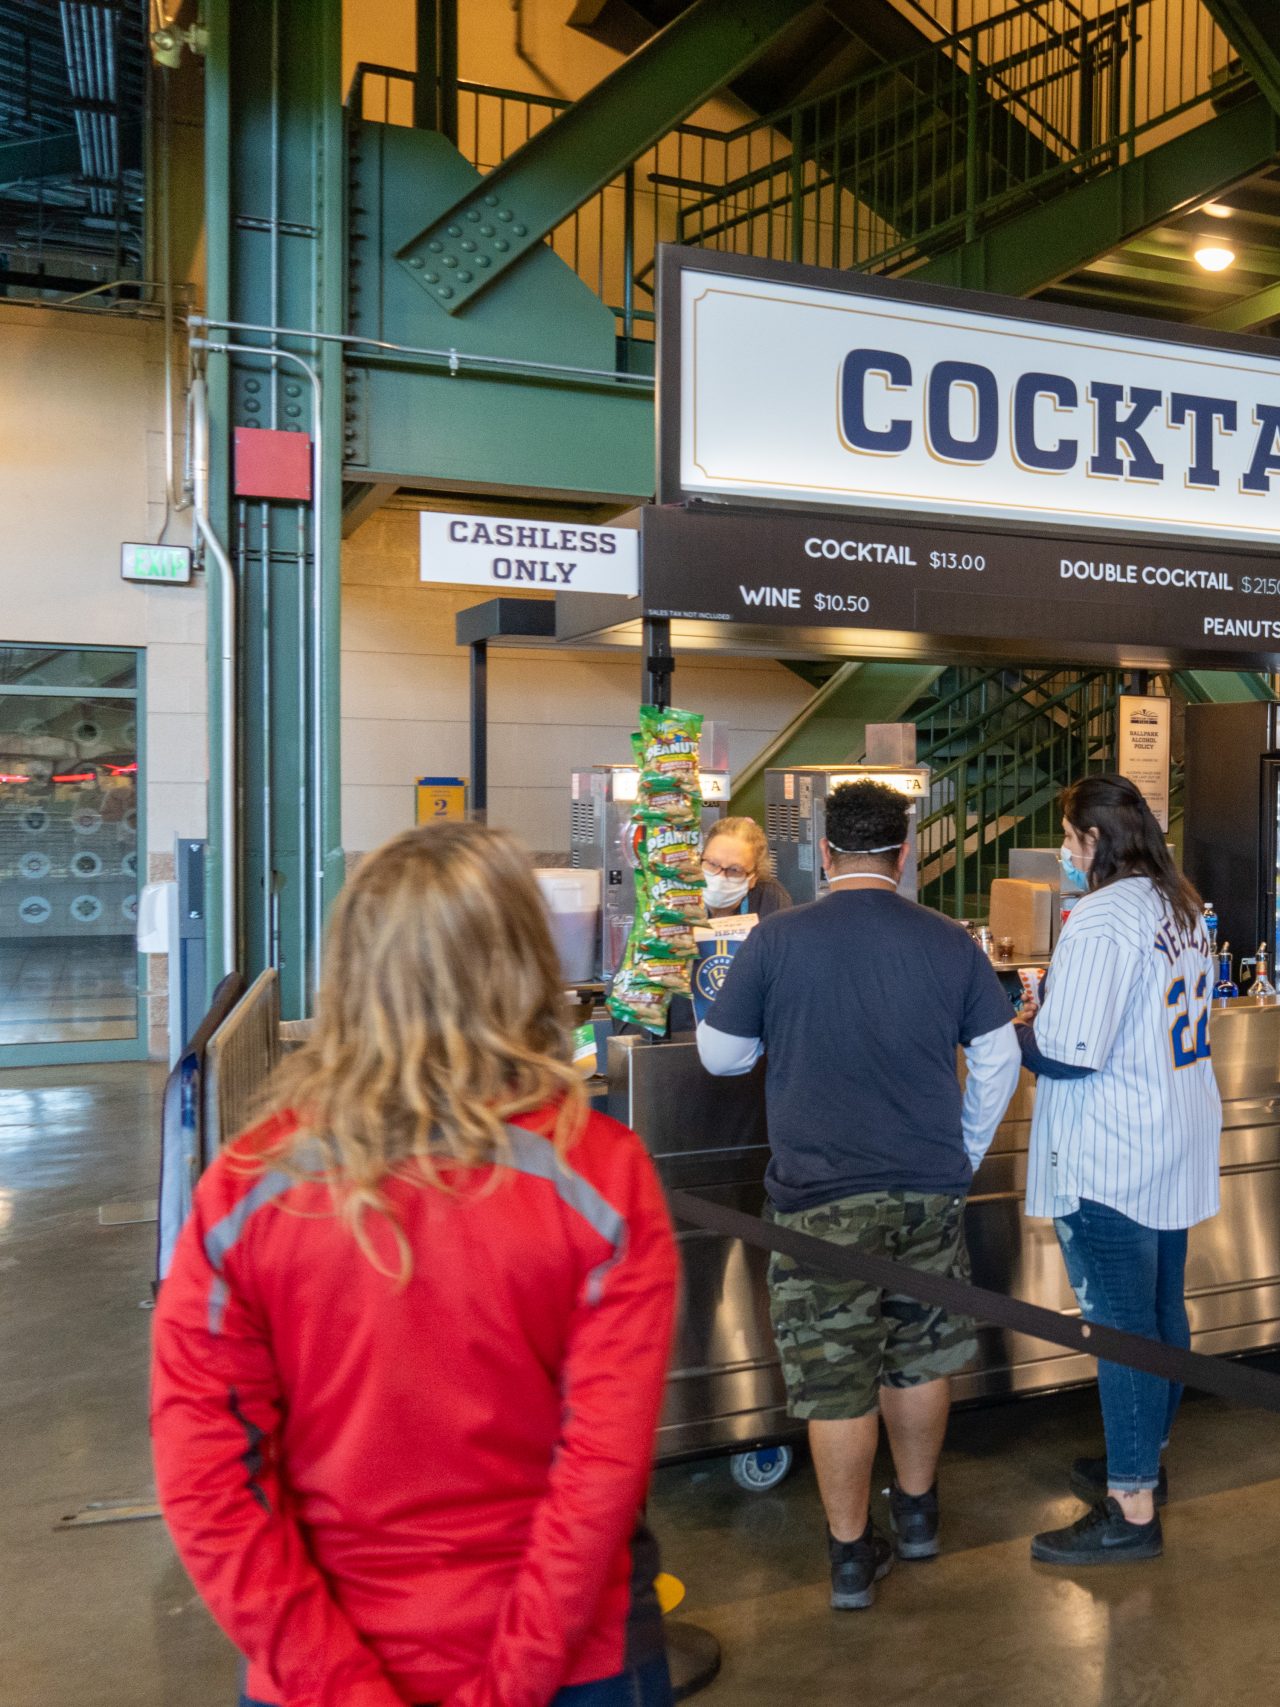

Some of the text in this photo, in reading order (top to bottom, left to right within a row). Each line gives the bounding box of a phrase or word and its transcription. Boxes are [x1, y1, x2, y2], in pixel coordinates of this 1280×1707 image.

[450, 520, 617, 555] CASHLESS
[134, 547, 179, 577] EXIT
[805, 538, 985, 571] COCKTAIL $13.00
[492, 557, 577, 584] ONLY
[1061, 560, 1137, 583] DOUBLE
[1142, 567, 1233, 590] COCKTAIL
[740, 585, 869, 612] WINE $10.50
[1129, 730, 1160, 738] BALLPARK
[1131, 736, 1158, 744] ALCOHOL
[646, 741, 698, 763] PEANUT
[434, 798, 448, 816] 2
[1164, 970, 1212, 1071] 22
